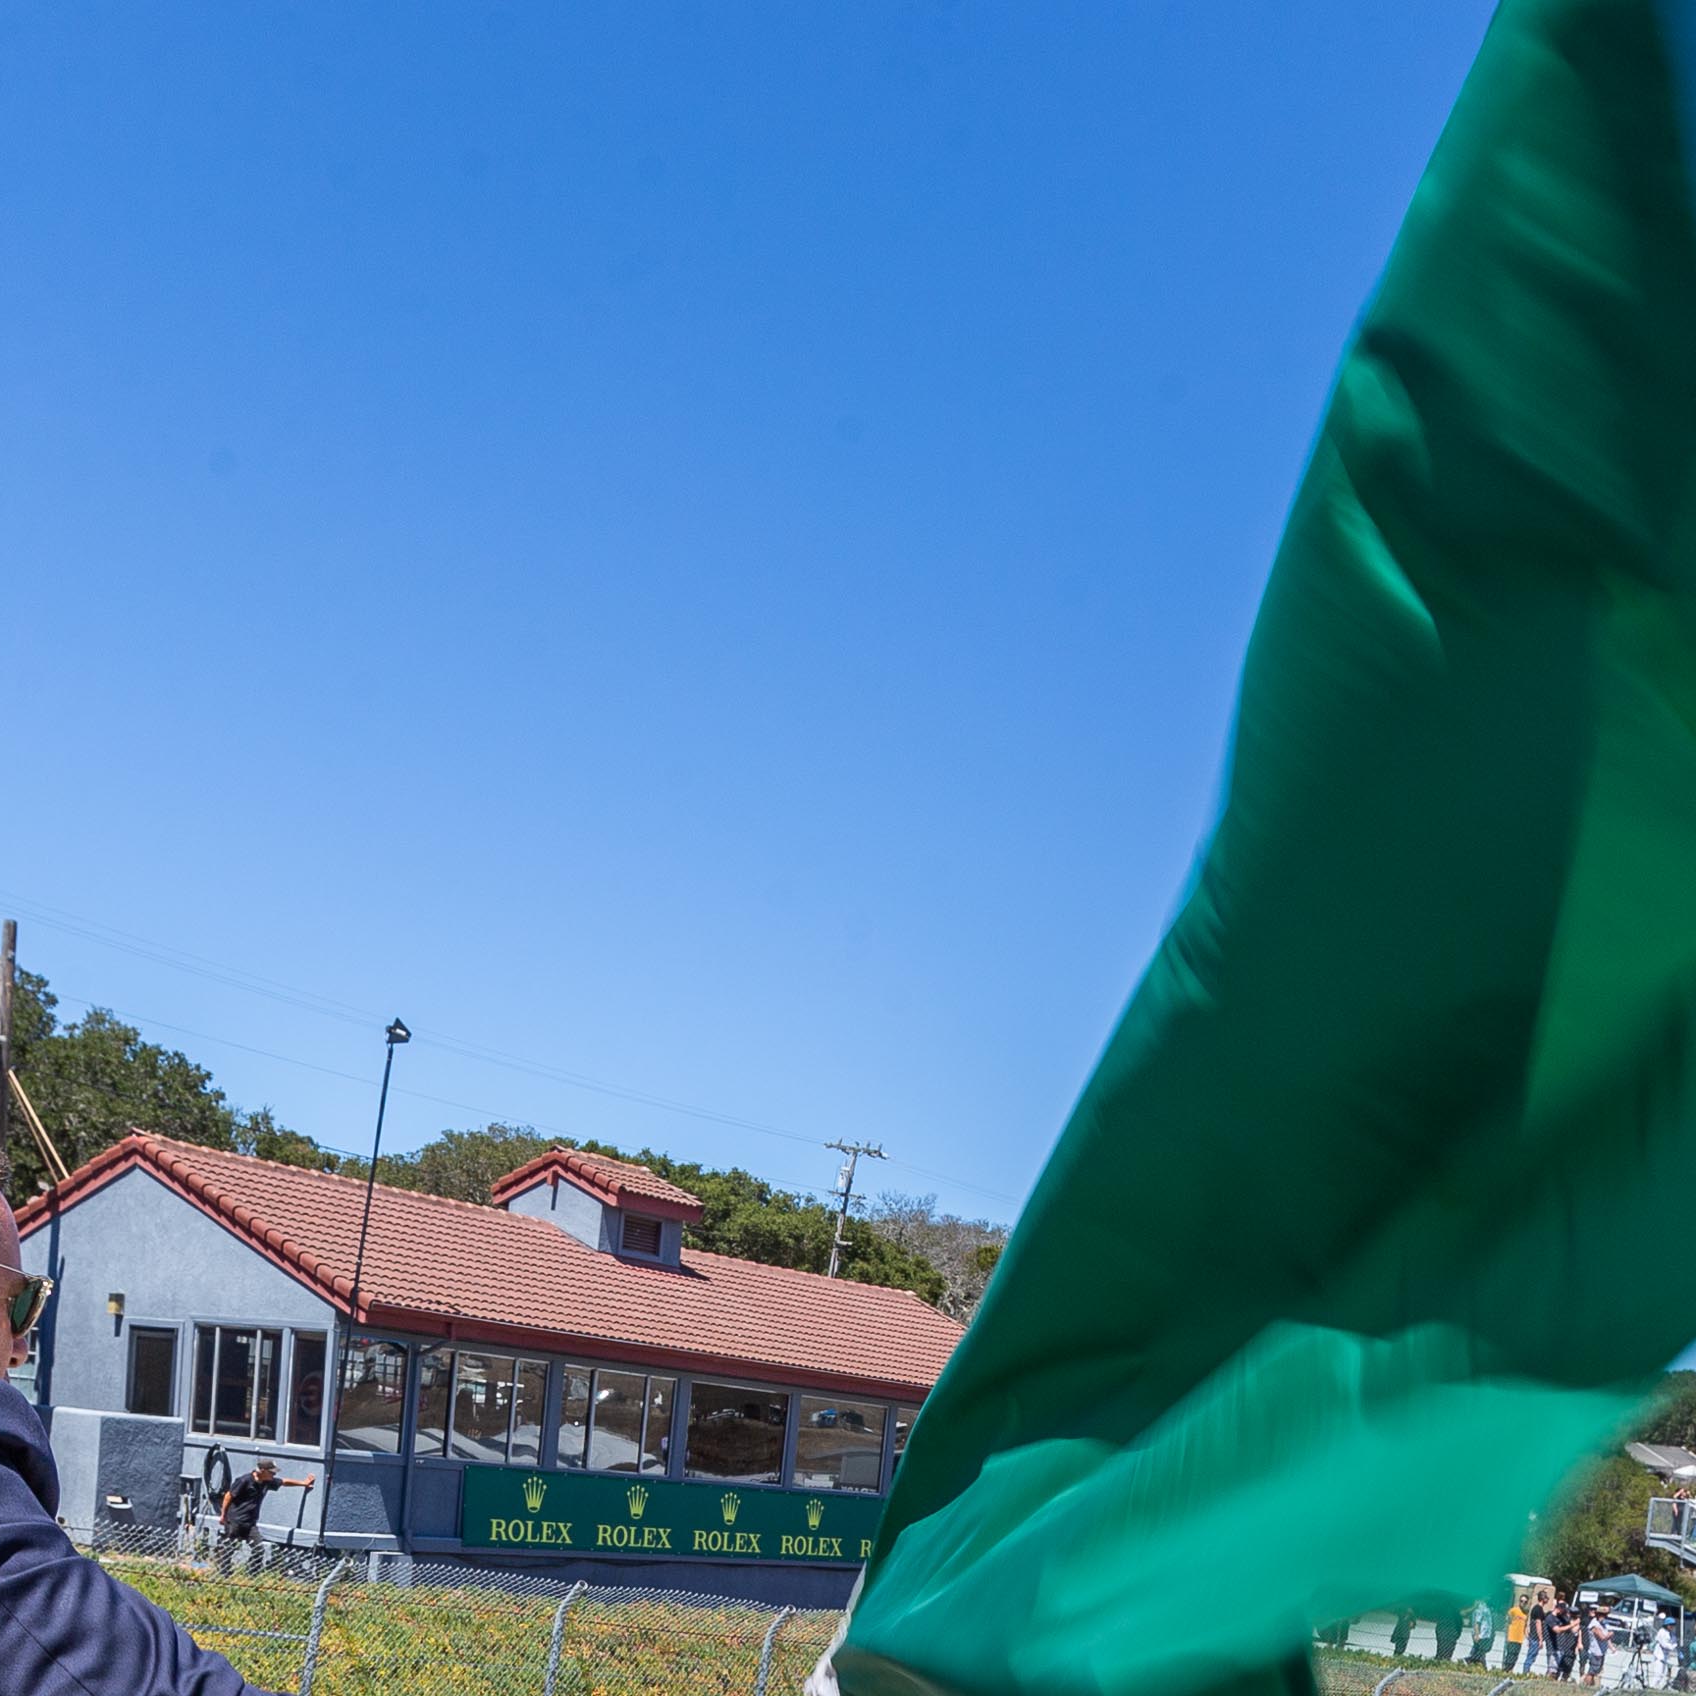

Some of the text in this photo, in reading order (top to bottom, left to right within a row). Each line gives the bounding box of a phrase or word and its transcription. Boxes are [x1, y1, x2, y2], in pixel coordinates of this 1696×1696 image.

[490, 1517, 573, 1545] ROLEX
[596, 1523, 672, 1549] ROLEX
[693, 1529, 762, 1554] ROLEX
[780, 1534, 843, 1558] ROLEX
